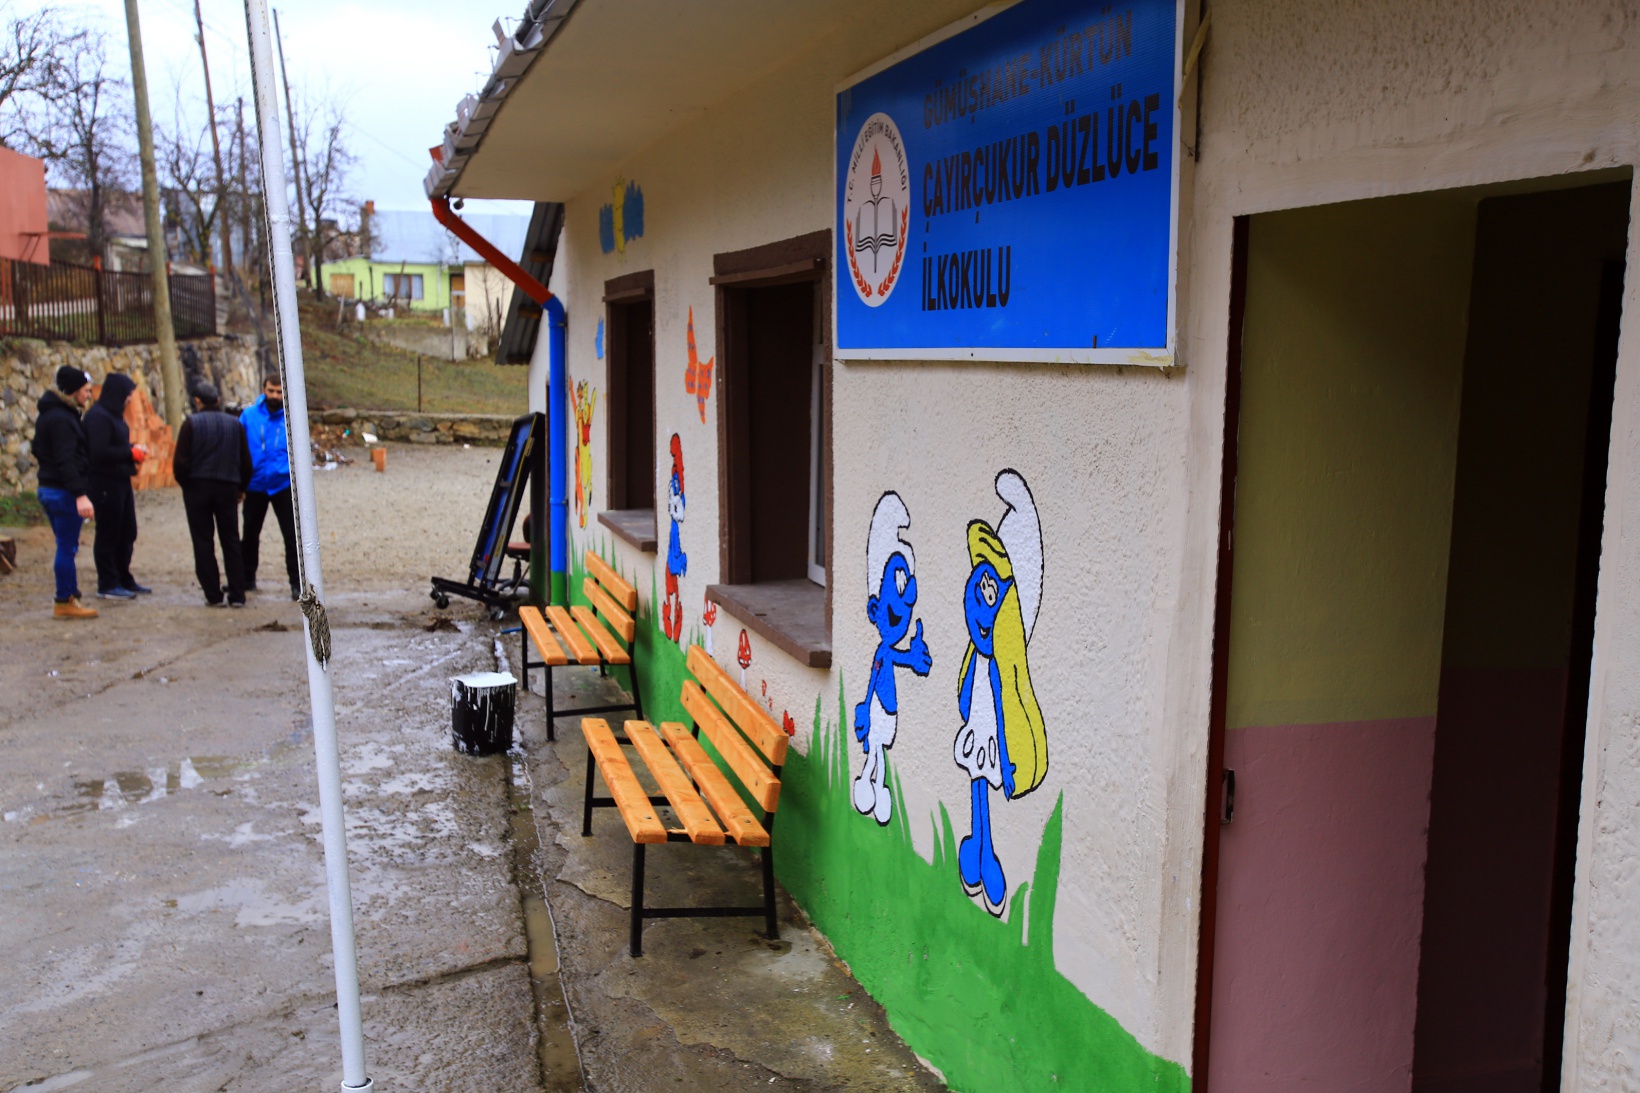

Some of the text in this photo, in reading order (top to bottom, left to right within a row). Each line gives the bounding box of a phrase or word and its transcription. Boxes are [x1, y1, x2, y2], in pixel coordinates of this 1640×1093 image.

[923, 83, 1160, 233] ÇAYIRÇUKUR DÜZLÜCE
[922, 241, 1011, 311] İLKOKULU
